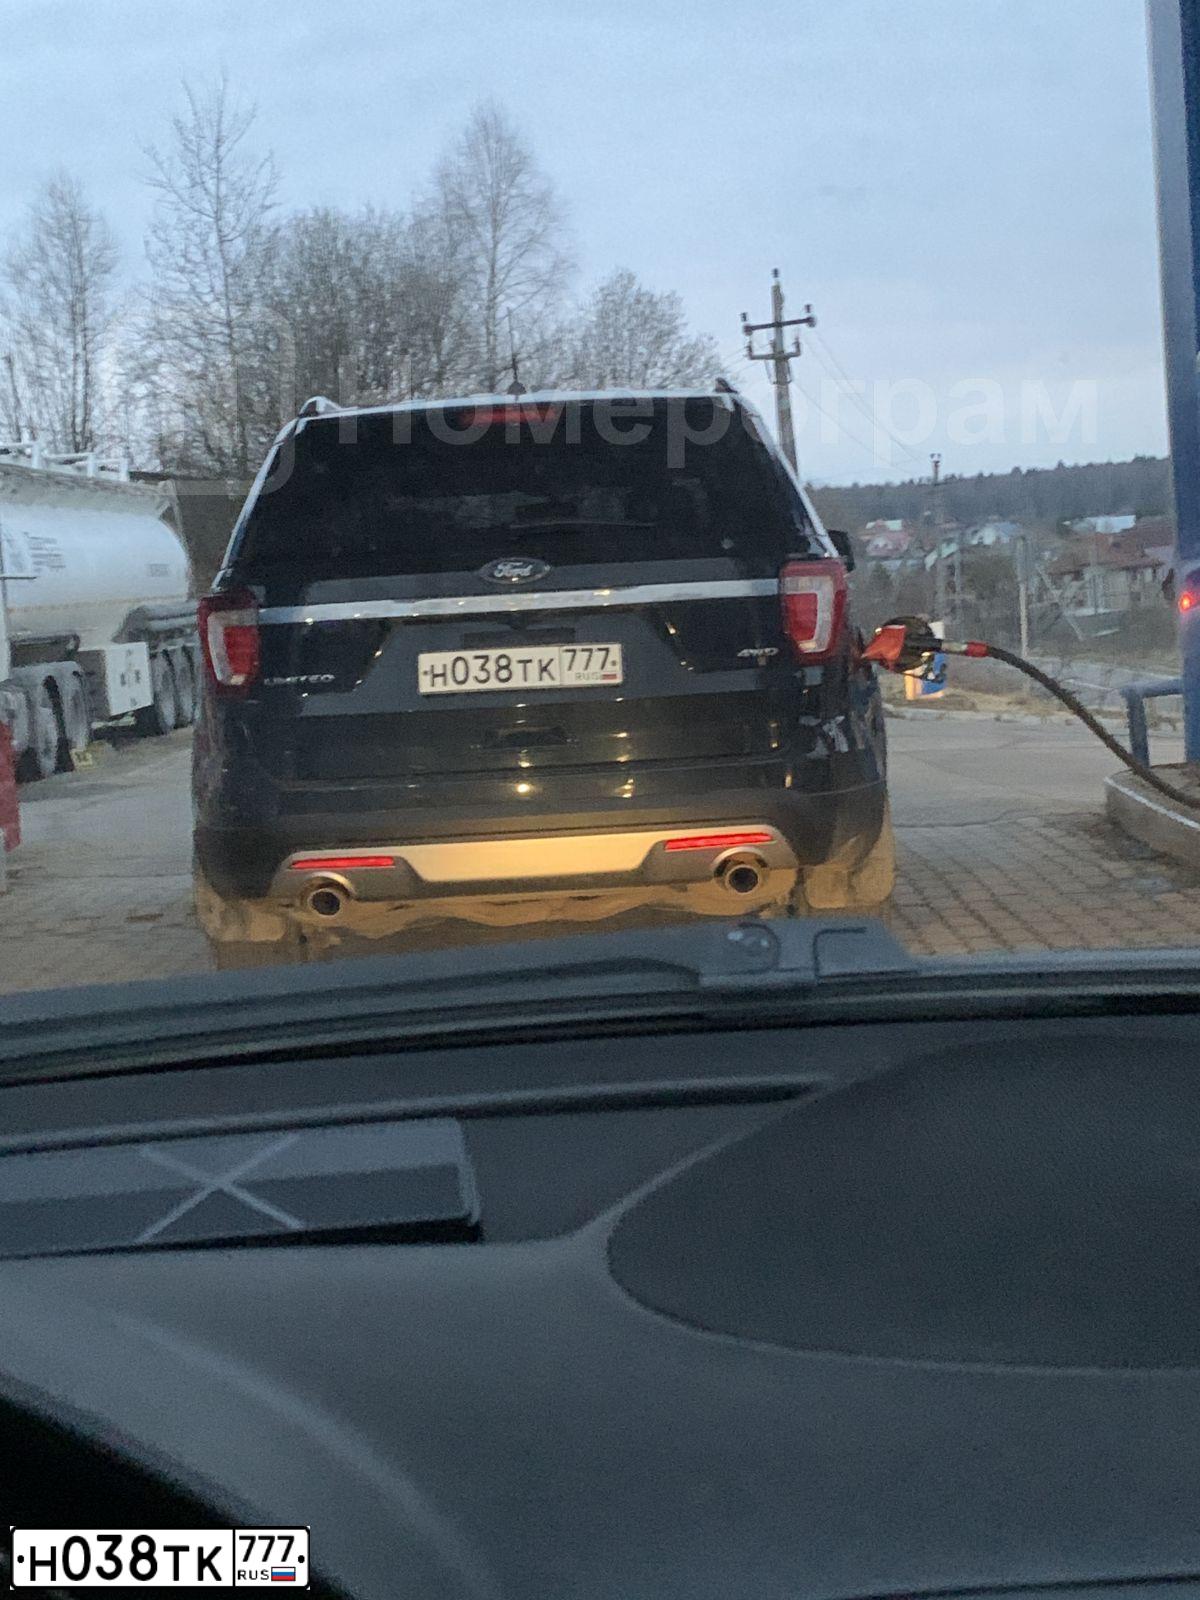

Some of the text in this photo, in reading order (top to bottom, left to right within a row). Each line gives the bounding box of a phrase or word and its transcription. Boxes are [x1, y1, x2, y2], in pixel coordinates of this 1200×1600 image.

[429, 647, 610, 688] Н038ТК 777
[575, 671, 602, 681] RUS
